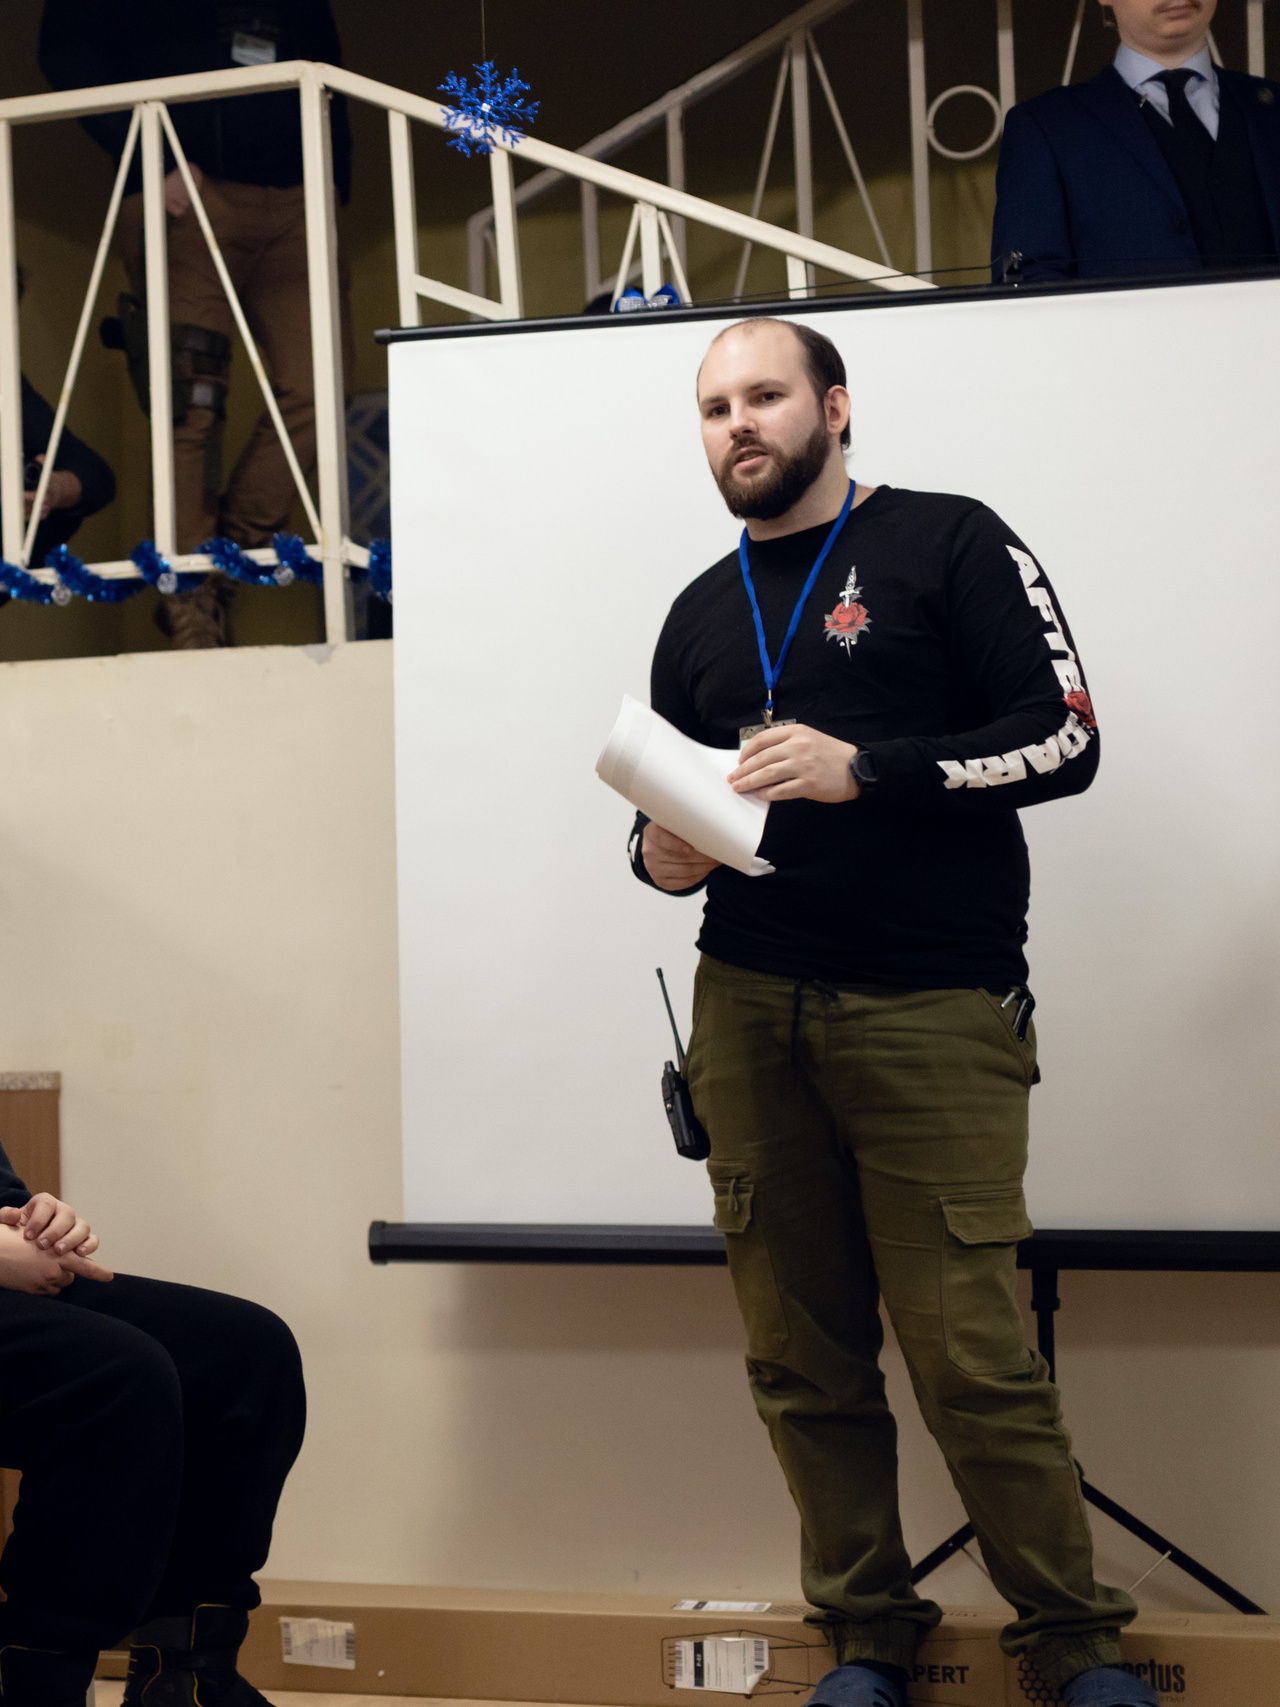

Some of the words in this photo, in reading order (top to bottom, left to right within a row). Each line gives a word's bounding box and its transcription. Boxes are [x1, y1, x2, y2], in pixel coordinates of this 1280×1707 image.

[1005, 545, 1091, 708] AFTE
[936, 719, 1091, 789] DARK
[907, 1665, 969, 1684] PERT
